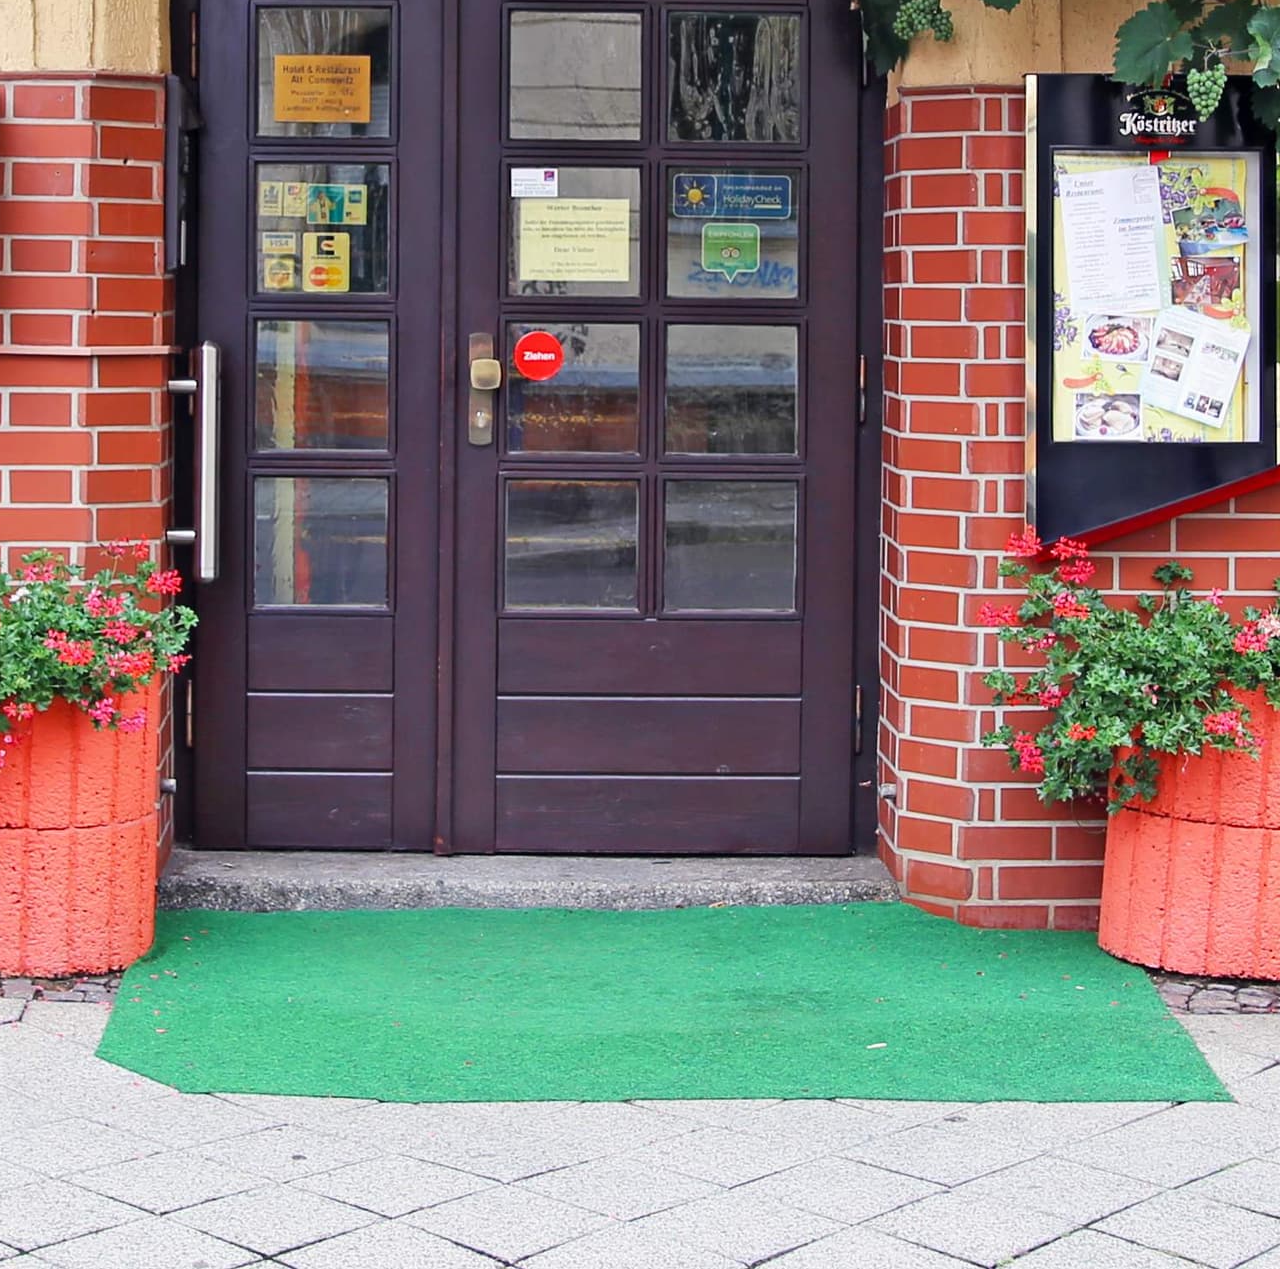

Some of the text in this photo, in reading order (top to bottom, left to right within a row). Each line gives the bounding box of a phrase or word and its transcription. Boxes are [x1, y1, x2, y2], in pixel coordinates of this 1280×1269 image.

[1120, 112, 1197, 136] Köstritzer
[723, 194, 782, 205] HolidayCheck
[523, 351, 556, 361] Ziehen
